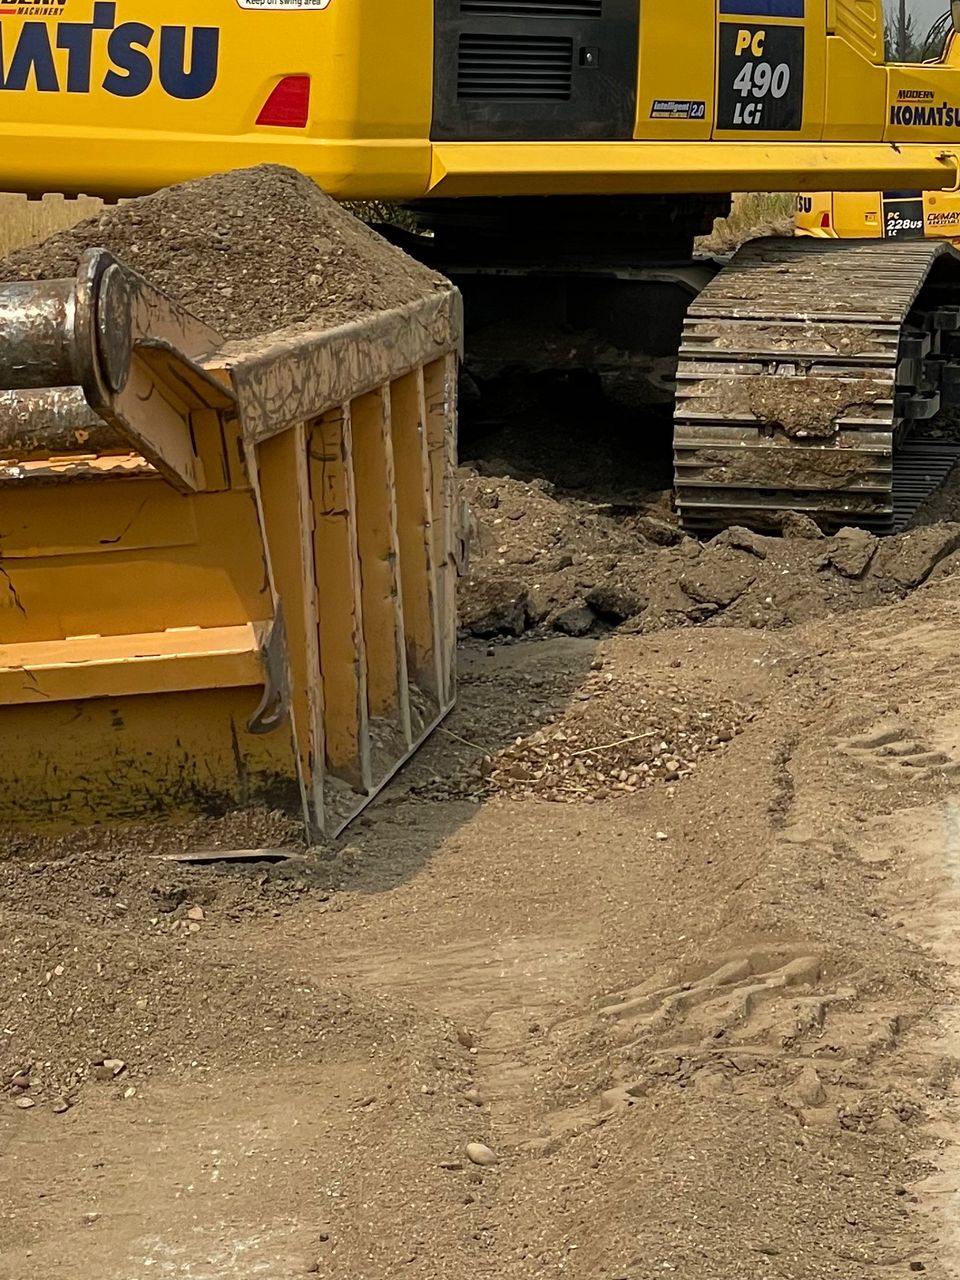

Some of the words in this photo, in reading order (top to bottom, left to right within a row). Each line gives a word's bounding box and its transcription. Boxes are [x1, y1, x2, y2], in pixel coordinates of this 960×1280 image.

[17, 7, 64, 16] MACHINERY
[0, 1, 220, 100] ATSU
[734, 29, 766, 57] PC
[733, 62, 790, 99] 490
[897, 90, 935, 99] MODERN
[691, 104, 704, 117] 2.0
[733, 103, 763, 124] LCi
[887, 212, 900, 220] PC
